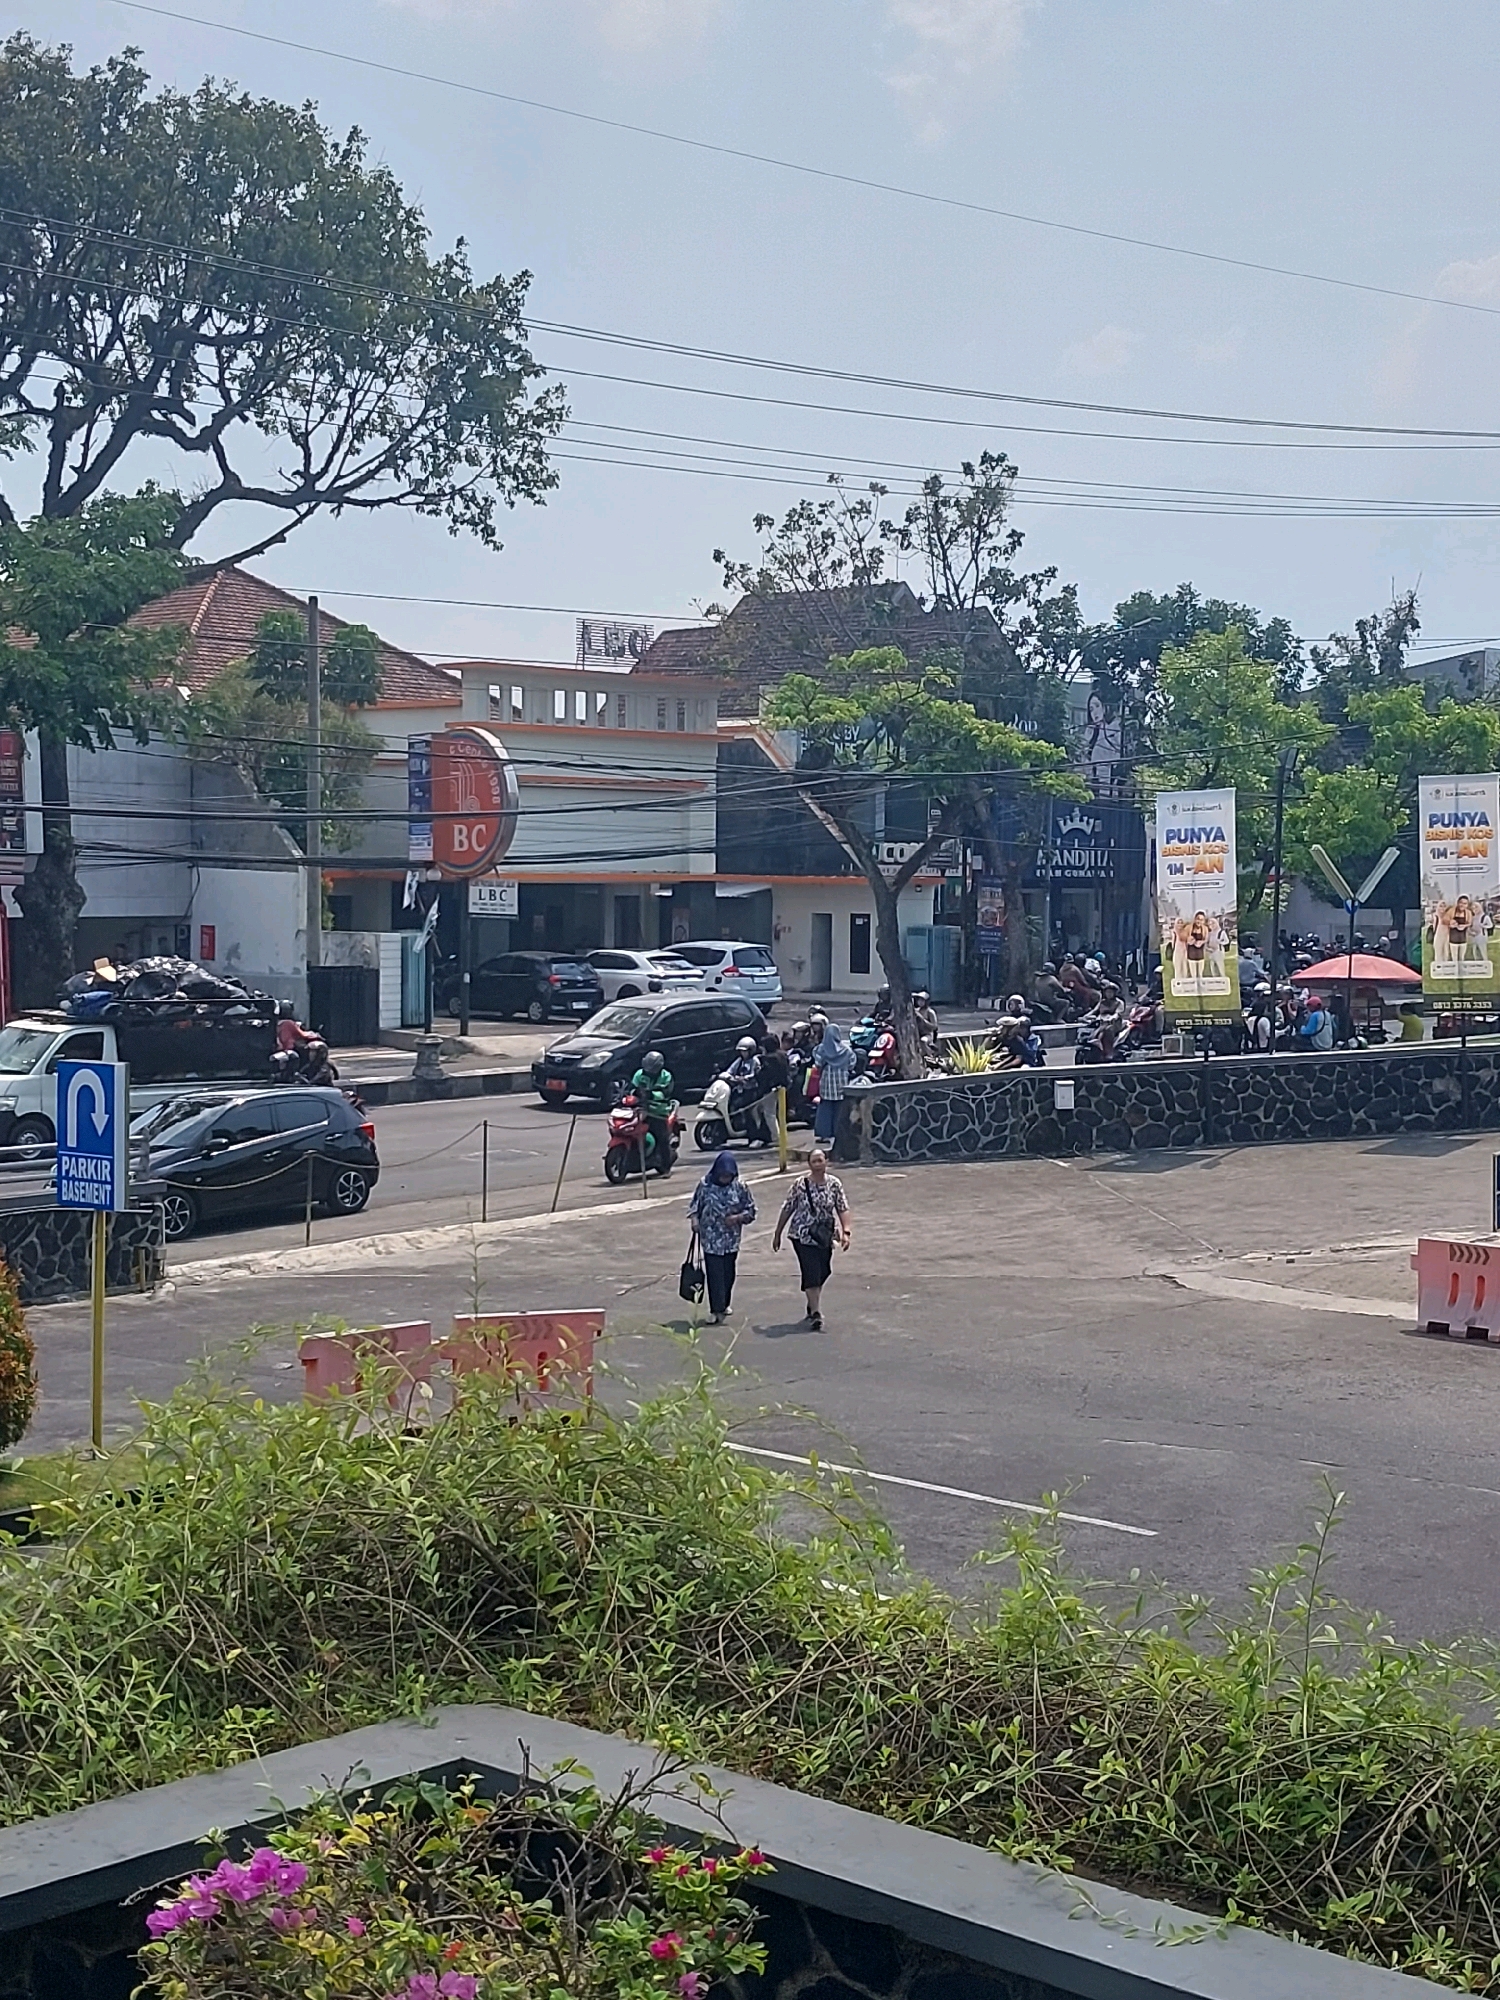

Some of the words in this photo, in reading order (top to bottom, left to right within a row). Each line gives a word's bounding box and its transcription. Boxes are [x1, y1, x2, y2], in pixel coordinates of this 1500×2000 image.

[1429, 811, 1490, 828] PUNYA
[1165, 826, 1226, 844] PUNYA
[1425, 829, 1465, 841] BISNIS
[1467, 828, 1494, 840] KOS
[1162, 845, 1200, 857] BISNIS
[1202, 844, 1229, 855] KOS
[62, 1155, 111, 1182] PARKIR
[62, 1179, 111, 1205] BASEMENT
